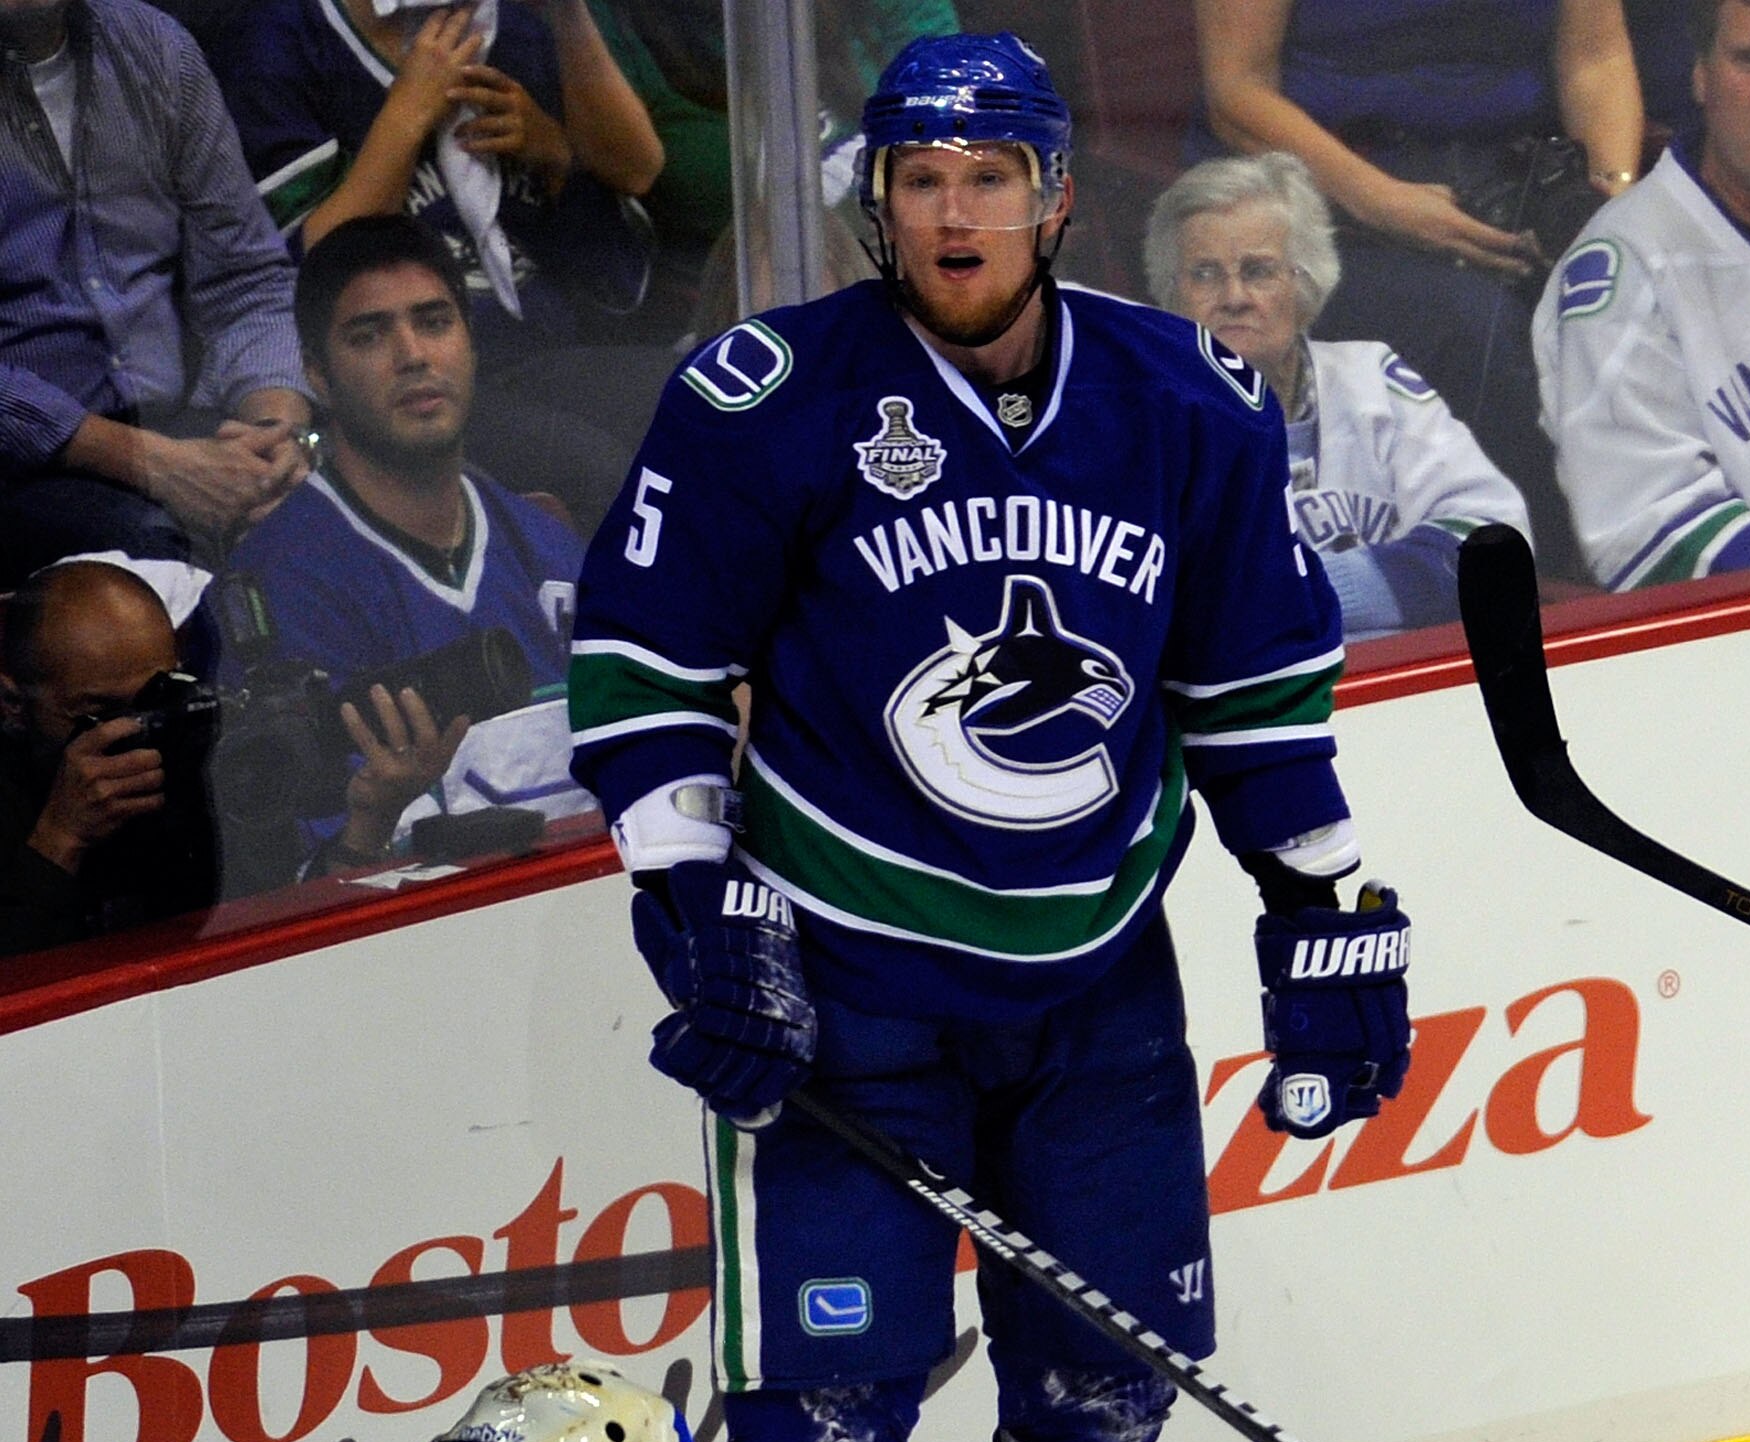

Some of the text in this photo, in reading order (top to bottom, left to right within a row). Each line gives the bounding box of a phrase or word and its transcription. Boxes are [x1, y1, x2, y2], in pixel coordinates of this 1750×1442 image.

[868, 447, 938, 463] FINAL
[624, 467, 672, 568] 5
[853, 495, 1166, 605] VANCOUVER
[722, 880, 796, 932] WA
[907, 1179, 1016, 1259] WARRIOR
